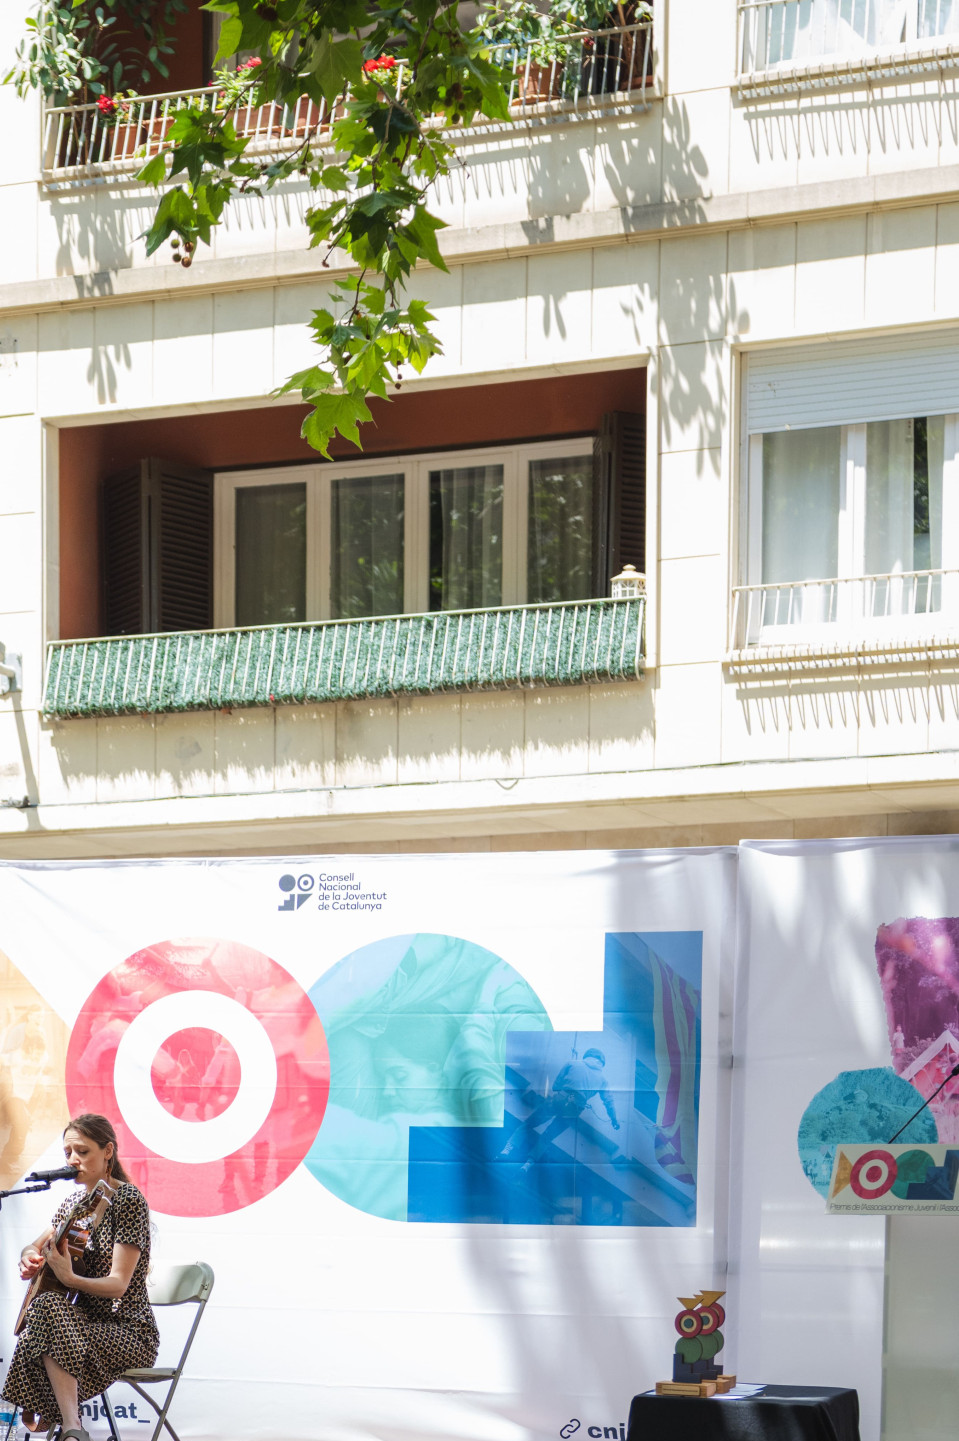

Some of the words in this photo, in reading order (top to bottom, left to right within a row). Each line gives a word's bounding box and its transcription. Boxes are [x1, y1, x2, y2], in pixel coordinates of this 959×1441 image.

[319, 872, 355, 882] Consell
[318, 882, 361, 891] Nacional
[318, 892, 330, 901] de
[332, 892, 341, 901] la
[343, 892, 388, 901] Joventut
[318, 902, 330, 911] de
[331, 902, 382, 912] Catalunya
